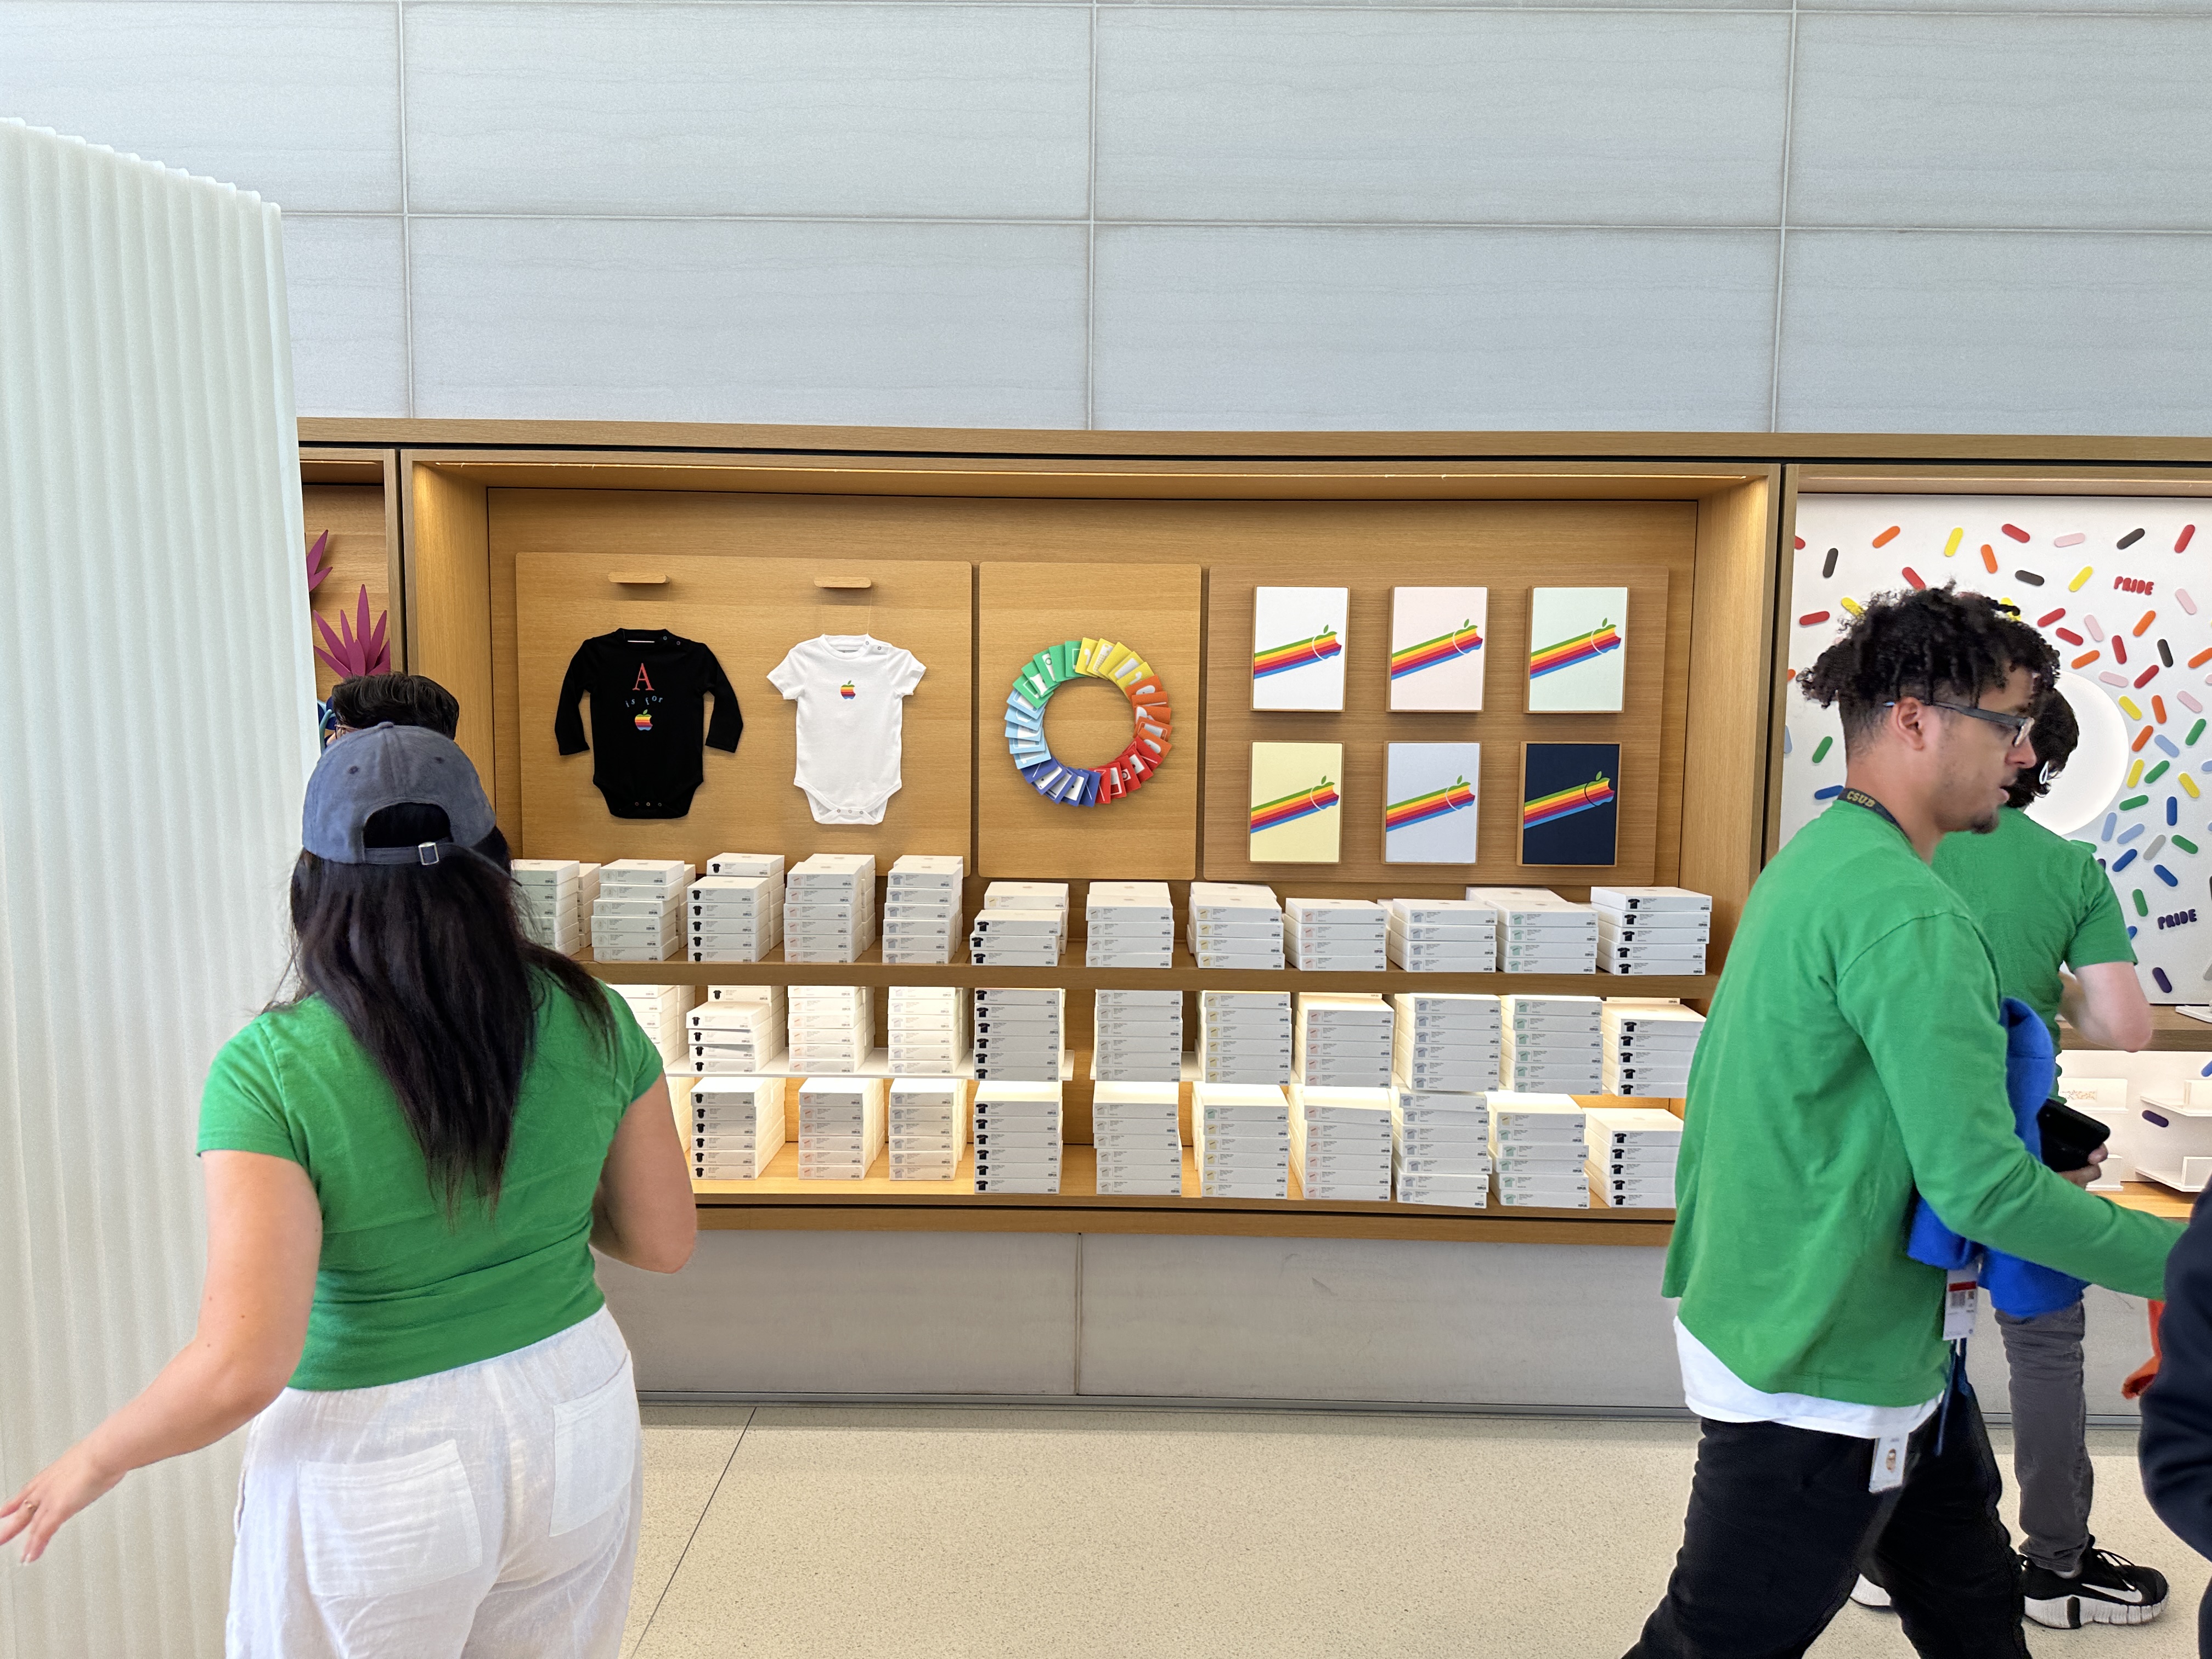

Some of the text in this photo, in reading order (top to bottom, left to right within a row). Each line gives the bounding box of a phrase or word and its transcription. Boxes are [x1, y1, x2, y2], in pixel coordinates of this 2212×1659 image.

[2113, 576, 2154, 595] PRIDE
[632, 662, 655, 691] A
[625, 695, 663, 708] is for
[2157, 909, 2197, 930] PRIDE
